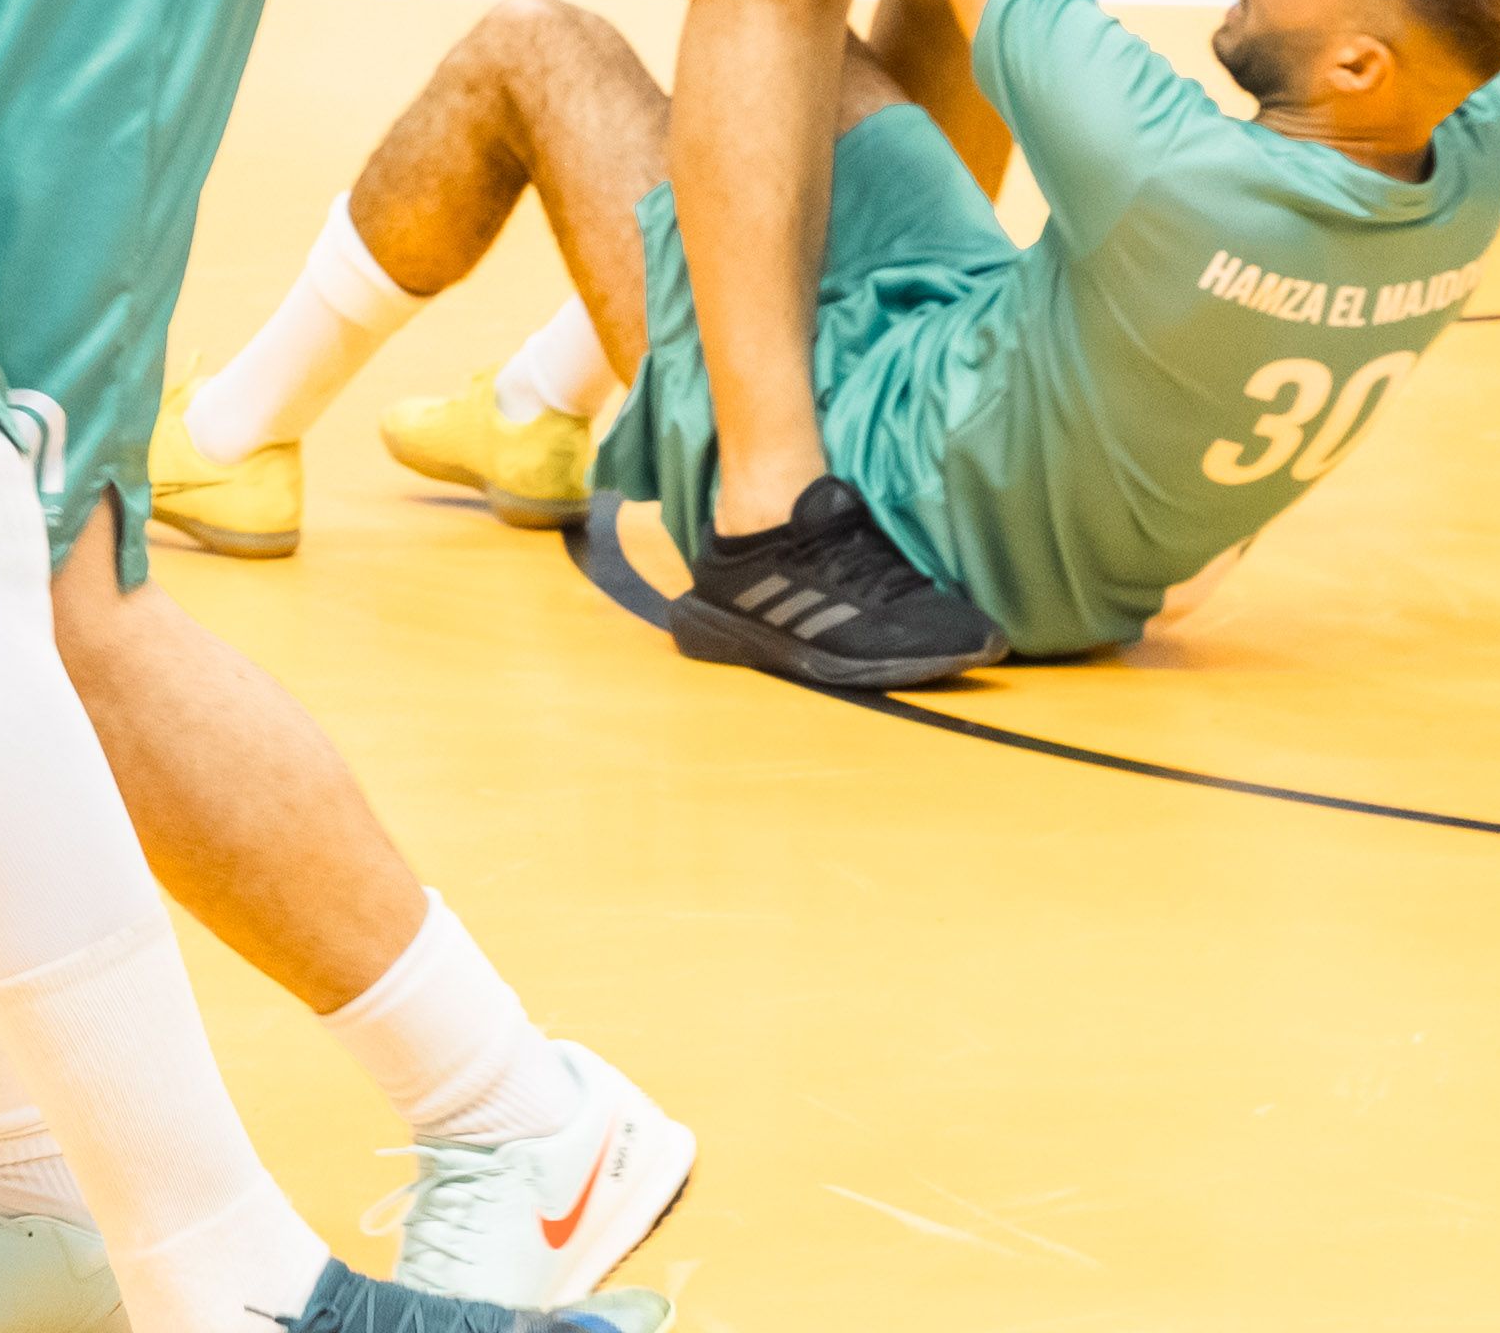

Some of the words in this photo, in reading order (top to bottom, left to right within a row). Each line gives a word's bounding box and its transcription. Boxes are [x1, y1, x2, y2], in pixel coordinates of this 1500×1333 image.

[1197, 249, 1328, 325] HAMZA
[1327, 285, 1367, 327] EL
[1202, 350, 1423, 486] 30
